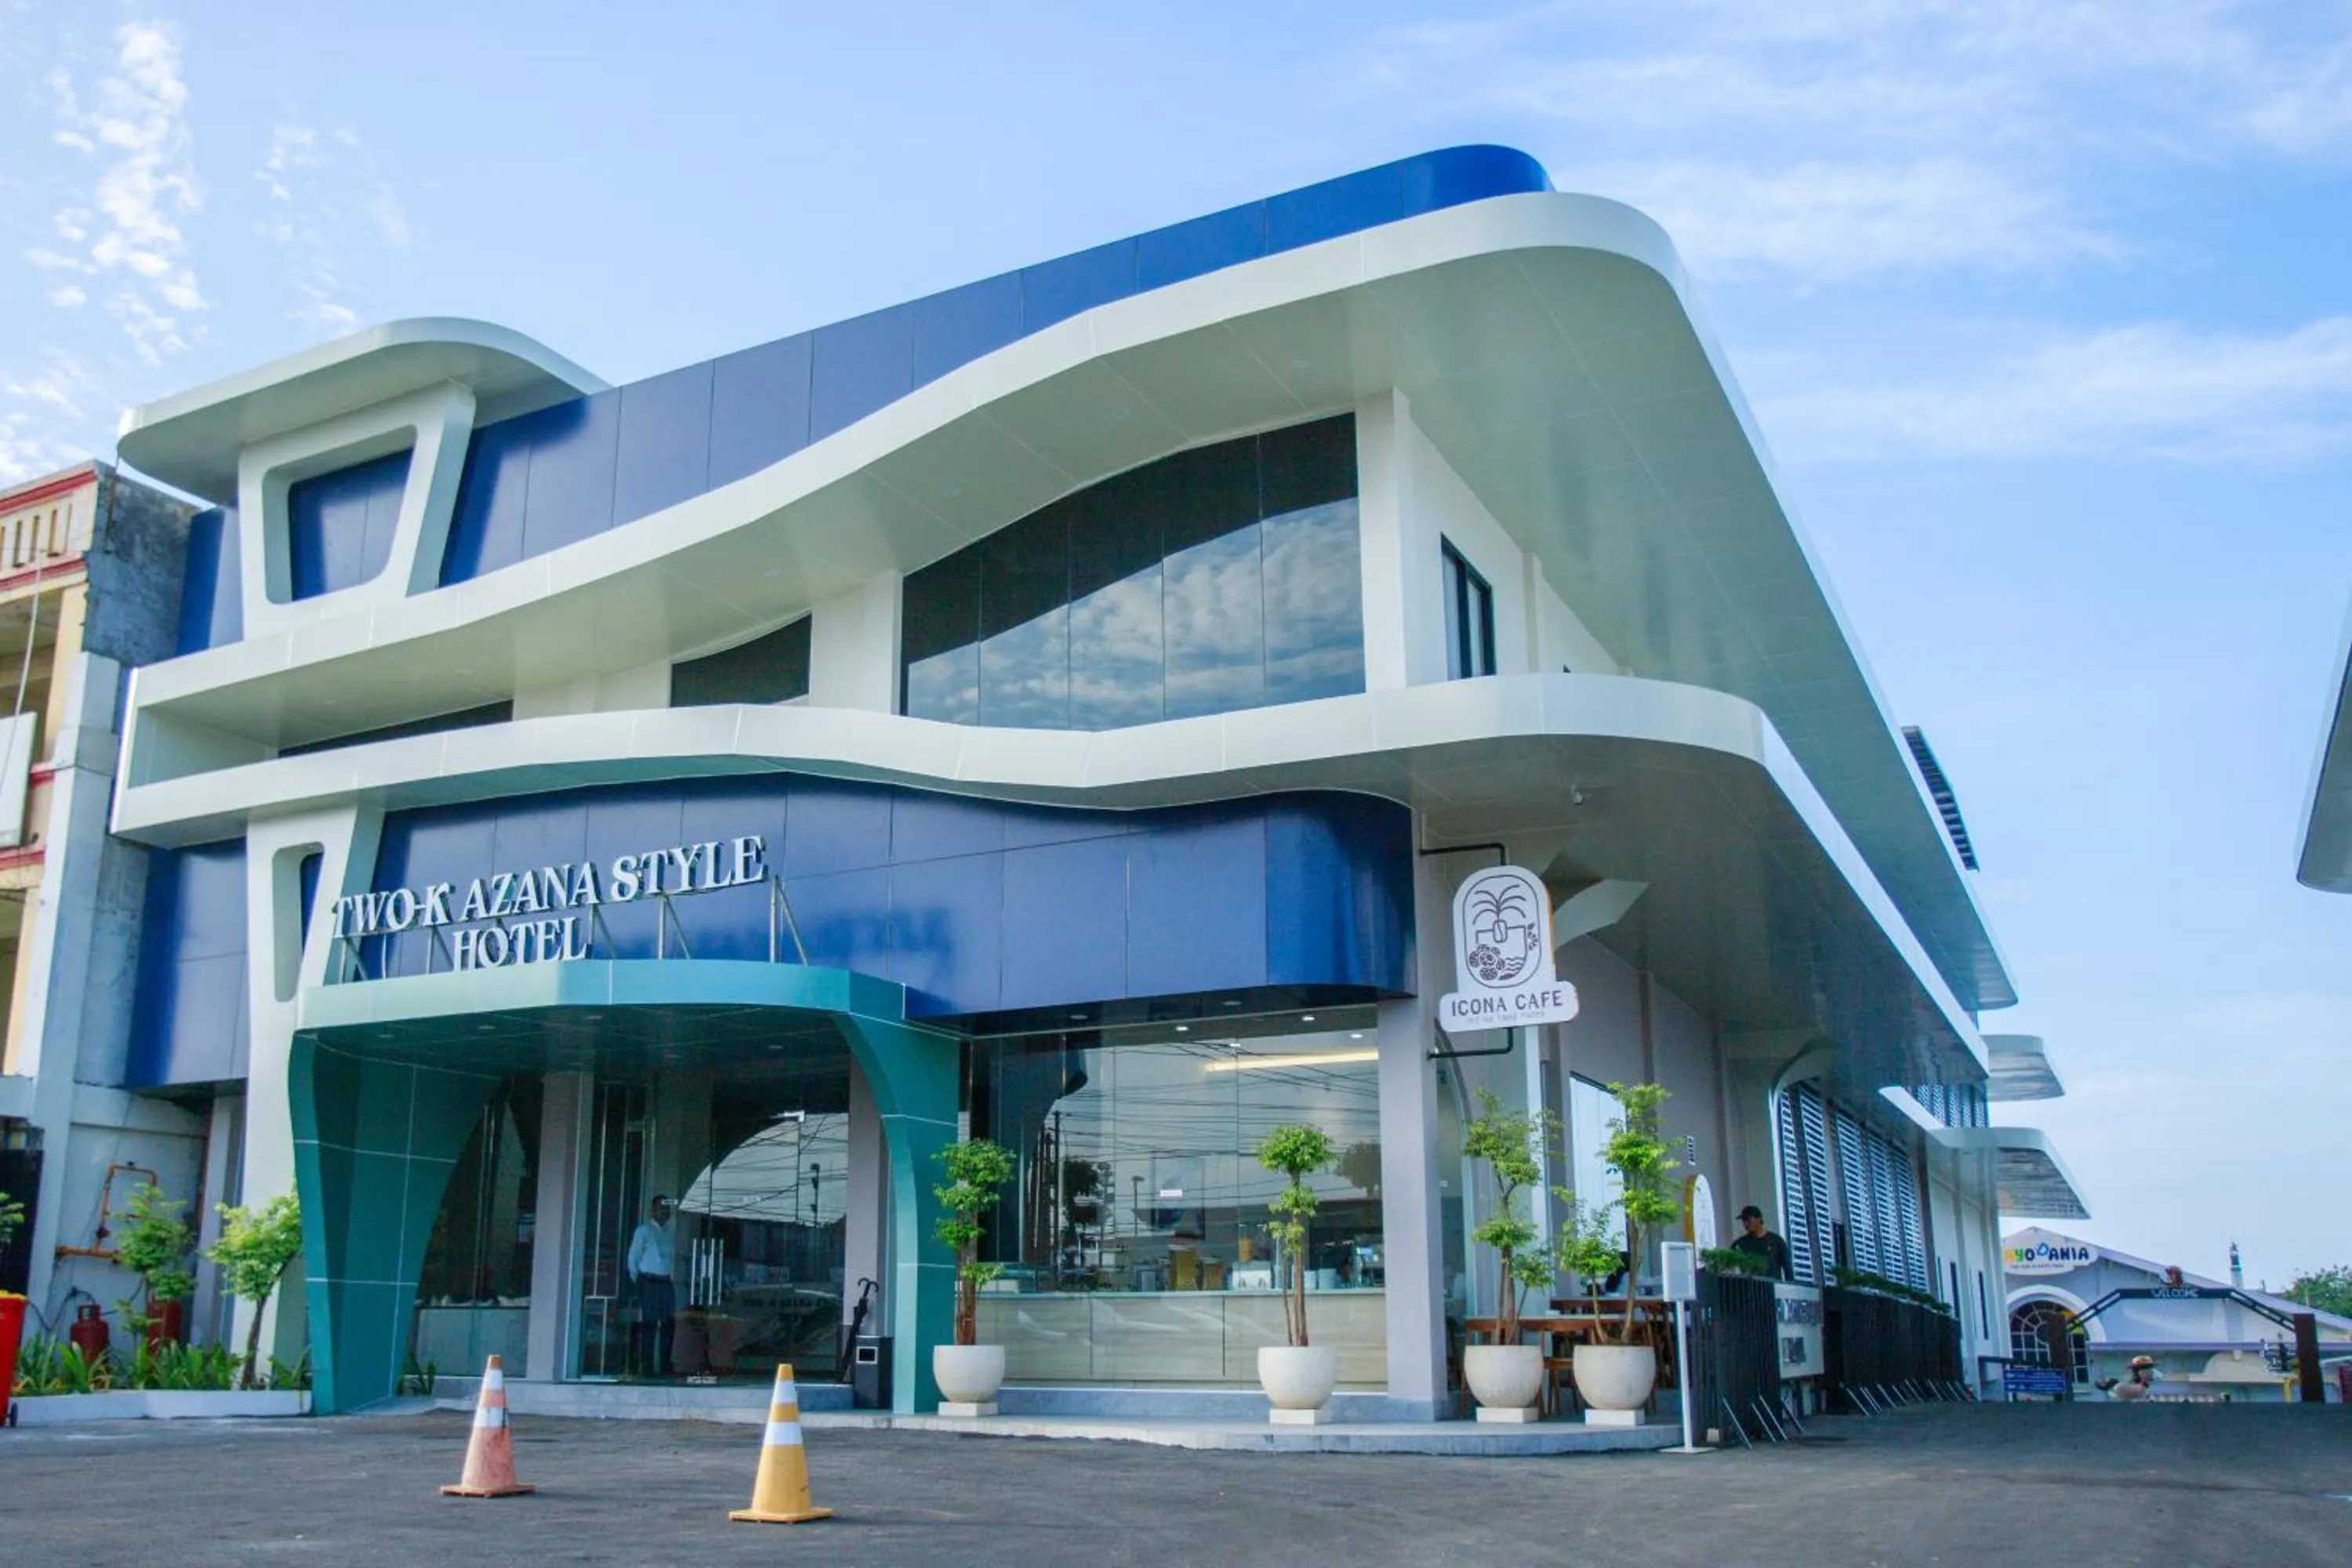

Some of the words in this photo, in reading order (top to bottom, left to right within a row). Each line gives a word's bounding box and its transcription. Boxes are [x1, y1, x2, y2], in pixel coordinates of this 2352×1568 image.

[332, 883, 450, 938] TWO-K
[458, 861, 601, 922] AZANA
[611, 835, 765, 902] STYLE
[452, 916, 588, 974] HOTEL
[1451, 996, 1507, 1017] ICONA
[1515, 990, 1563, 1011] CAFE
